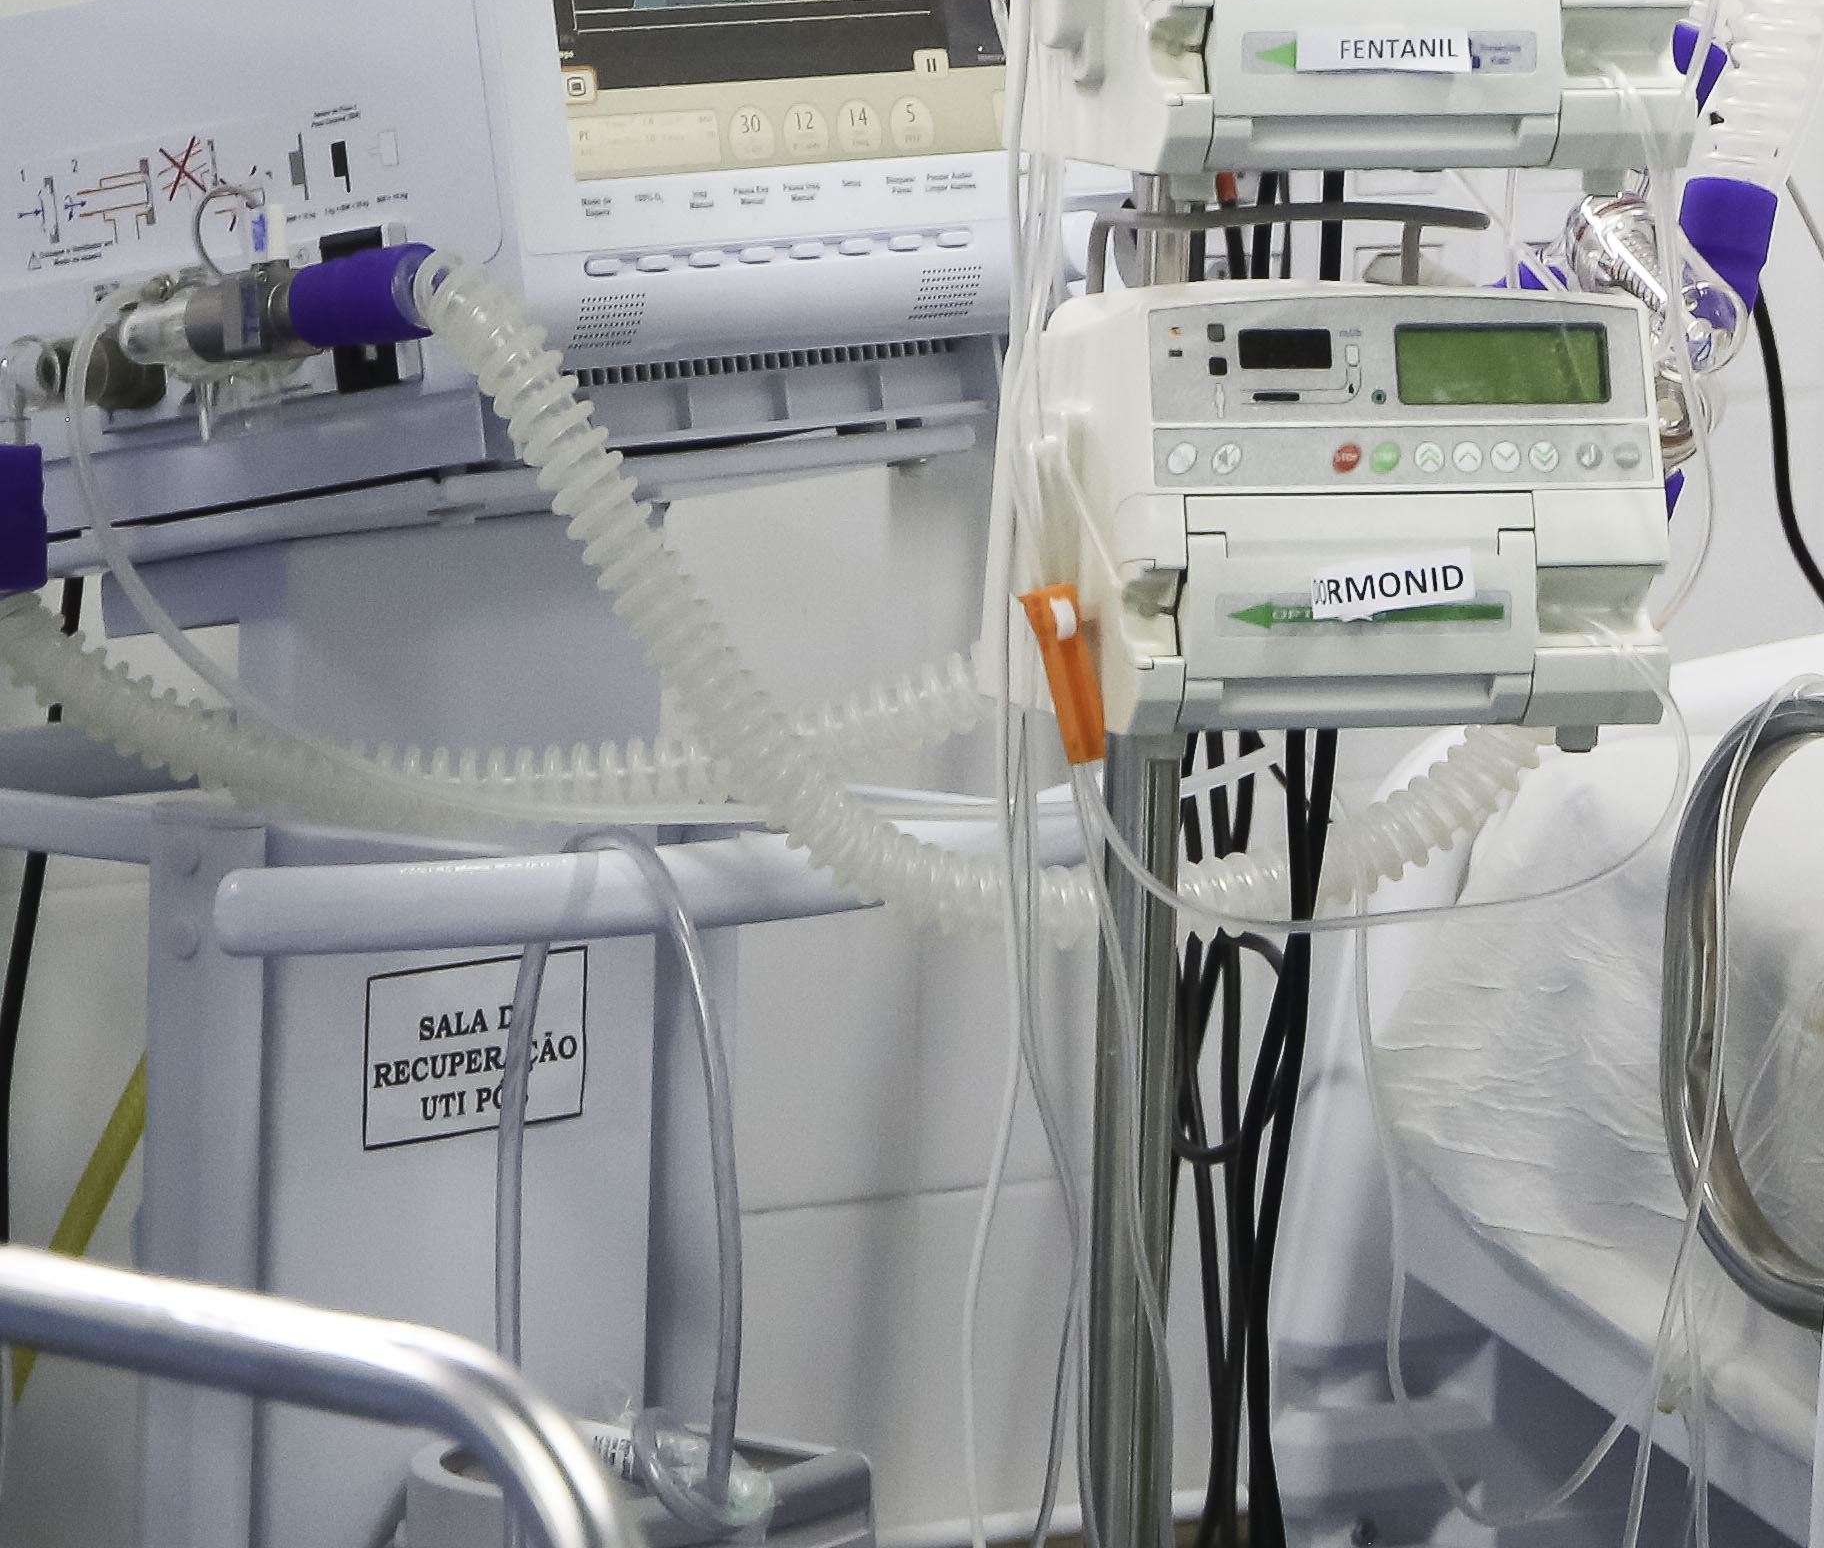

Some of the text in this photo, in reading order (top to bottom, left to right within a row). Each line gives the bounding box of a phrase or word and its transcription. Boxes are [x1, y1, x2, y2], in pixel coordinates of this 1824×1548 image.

[1339, 37, 1460, 60] FENTANIL
[739, 113, 761, 134] 30
[794, 110, 814, 131] 12
[849, 107, 868, 127] 14
[905, 103, 916, 123] 5
[419, 1008, 489, 1041] SALA
[373, 1031, 578, 1089] RECUPERÃO
[420, 1077, 529, 1121] UTI PÓ
